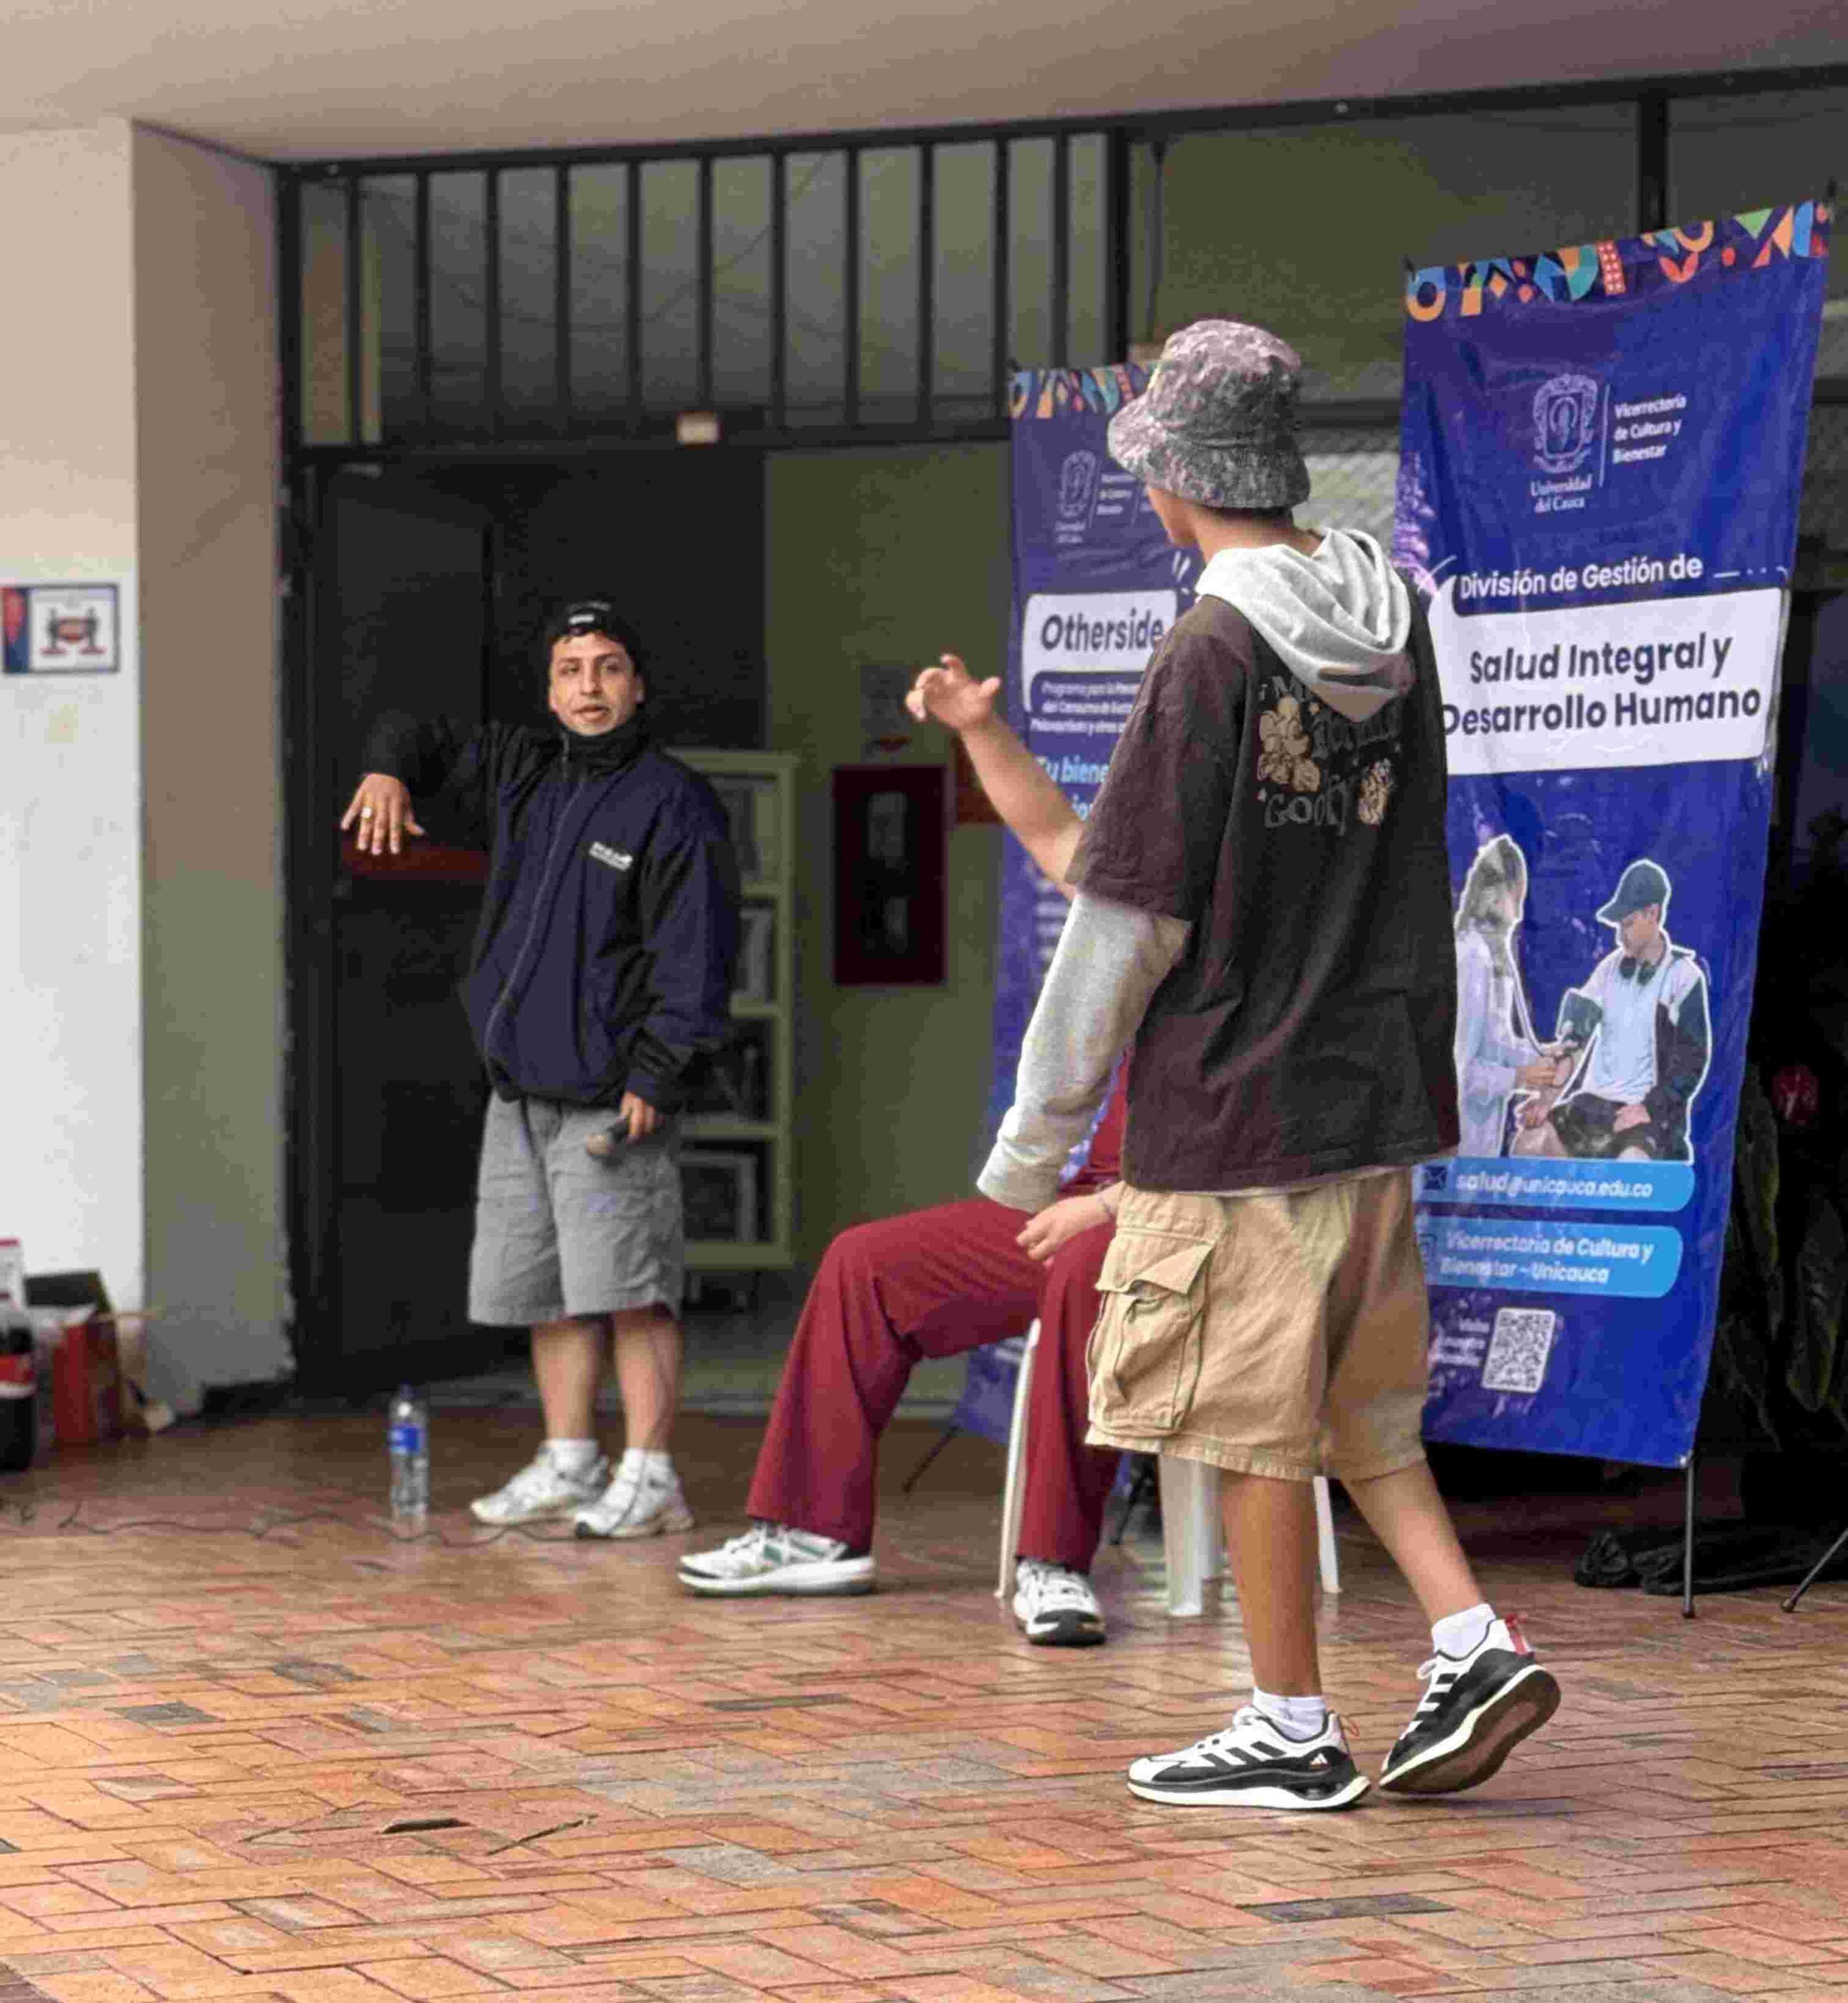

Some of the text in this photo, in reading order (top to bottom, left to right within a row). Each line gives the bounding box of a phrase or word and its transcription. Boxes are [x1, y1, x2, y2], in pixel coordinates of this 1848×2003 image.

[1613, 419, 1681, 441] de Cultura y
[1612, 444, 1667, 464] Bienestar
[1530, 473, 1592, 497] Universidad
[1534, 497, 1585, 513] del Cauca
[1461, 553, 1702, 600] División de Gestión de
[1041, 607, 1163, 651] Otherside
[1469, 631, 1733, 685] Salud Integral y
[1444, 693, 1606, 735] Desarrollo
[1614, 687, 1760, 727] Humano
[1061, 755, 1109, 782] biene
[1553, 1238, 1575, 1253] de
[1577, 1238, 1640, 1258] Cultura
[1641, 1243, 1654, 1265] y
[1531, 1260, 1609, 1284] Unicauca
